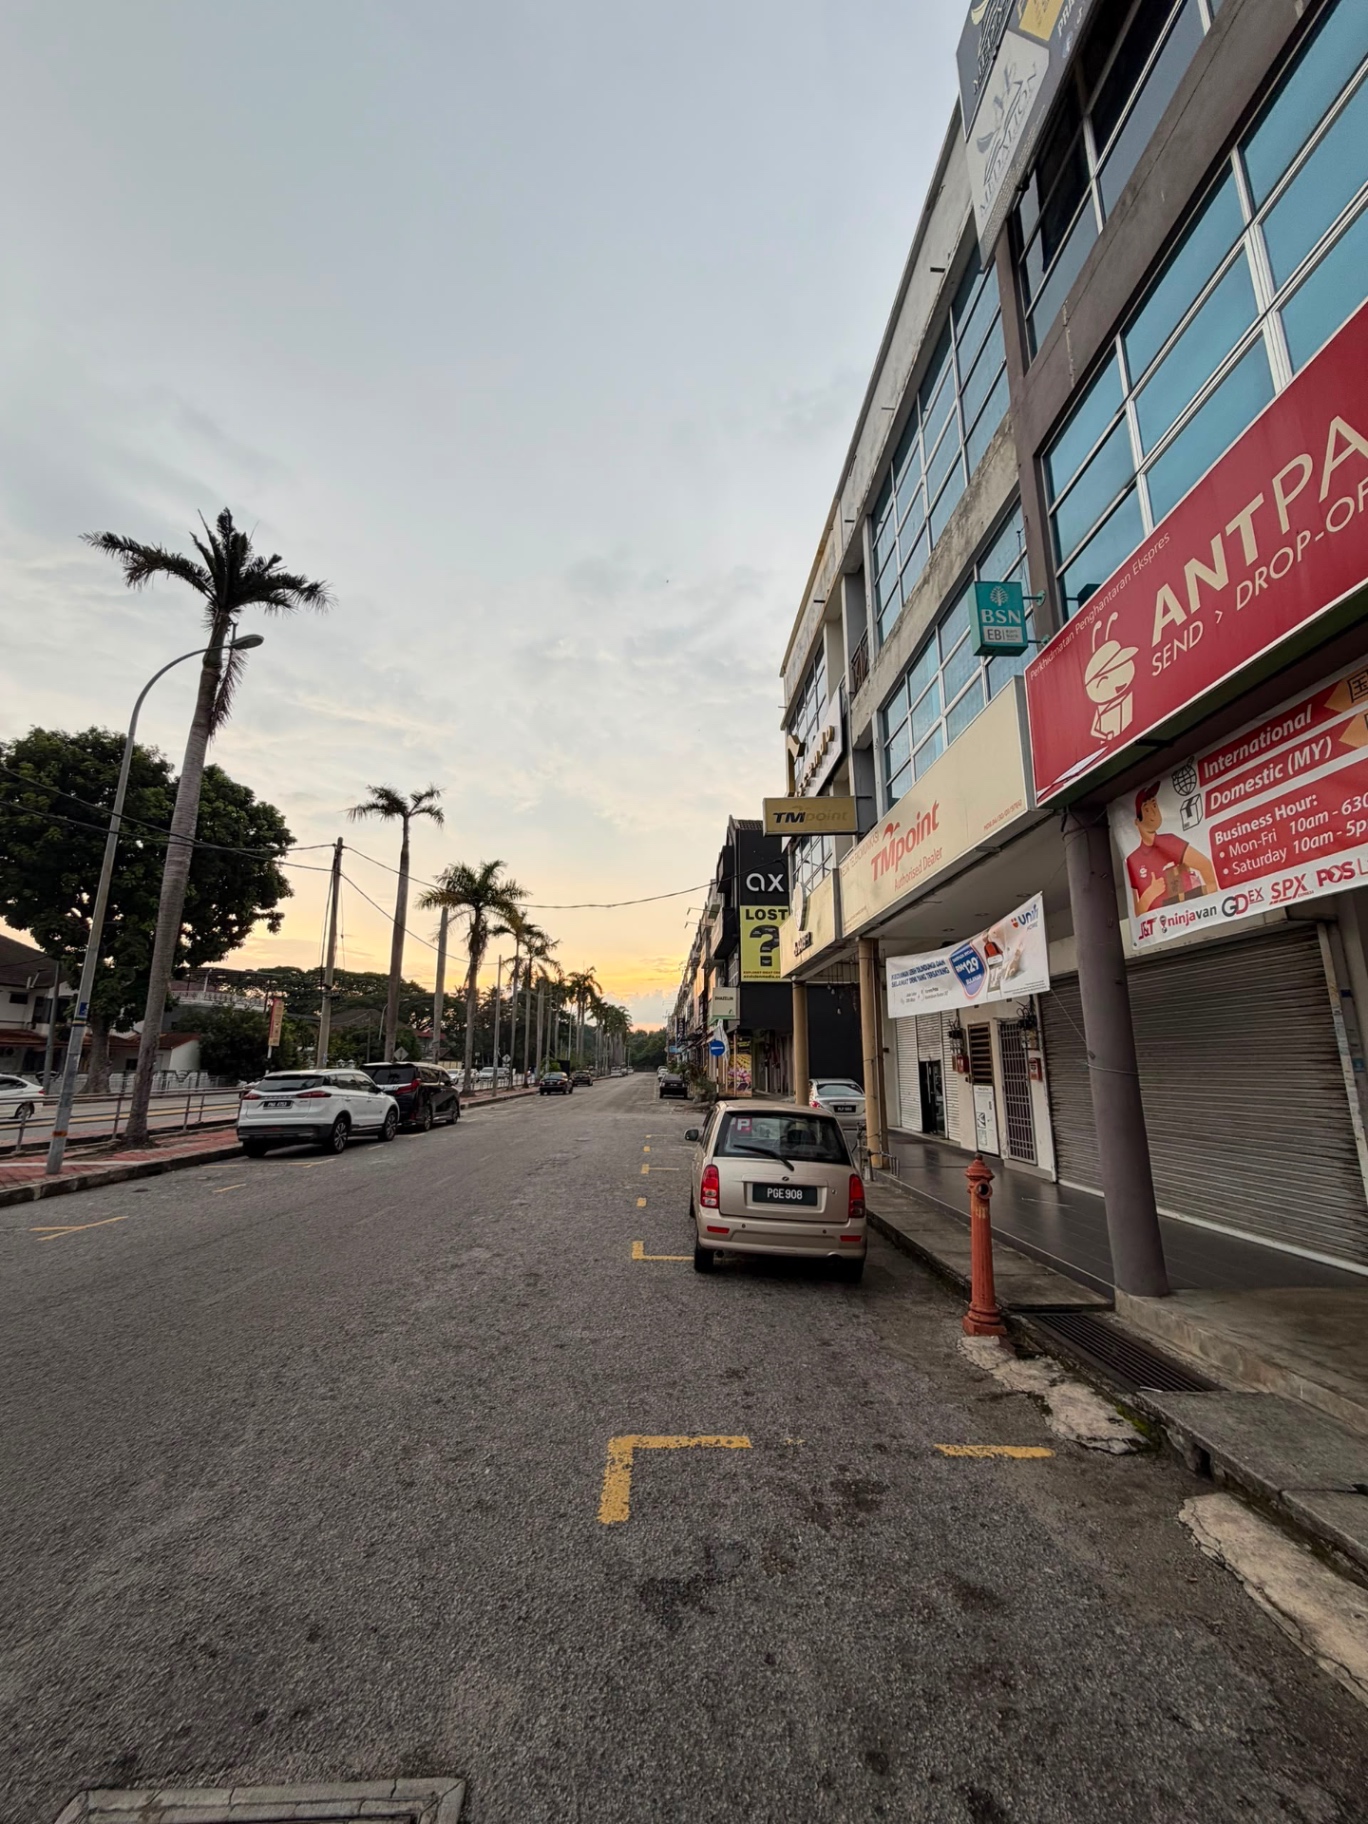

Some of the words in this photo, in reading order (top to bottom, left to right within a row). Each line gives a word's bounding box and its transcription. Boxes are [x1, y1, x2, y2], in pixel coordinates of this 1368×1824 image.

[980, 608, 1021, 624] BSN
[1030, 632, 1075, 680] Perkhidmatan
[1075, 573, 1131, 635] Penghantaran
[1132, 532, 1171, 576] Ekspres
[987, 628, 1002, 640] EB
[1152, 620, 1204, 677] SEND
[1204, 704, 1312, 779] International
[1210, 763, 1284, 811] Domestic
[1288, 735, 1332, 775] (MY)
[870, 800, 940, 883] TMpoint
[1214, 812, 1273, 846] Business
[1274, 793, 1318, 821] Hour:
[1228, 828, 1278, 858] Mon-Fri
[1289, 811, 1329, 836] 10am
[894, 861, 922, 892] Authorised
[922, 846, 944, 872] Dealer
[1232, 847, 1287, 875] Saturday
[1293, 831, 1334, 854] 10am
[746, 908, 788, 920] LOST
[1138, 916, 1158, 940] J&T
[1168, 904, 1217, 928] ninjavan
[1270, 872, 1308, 903] SPX
[1316, 861, 1356, 887] POS
